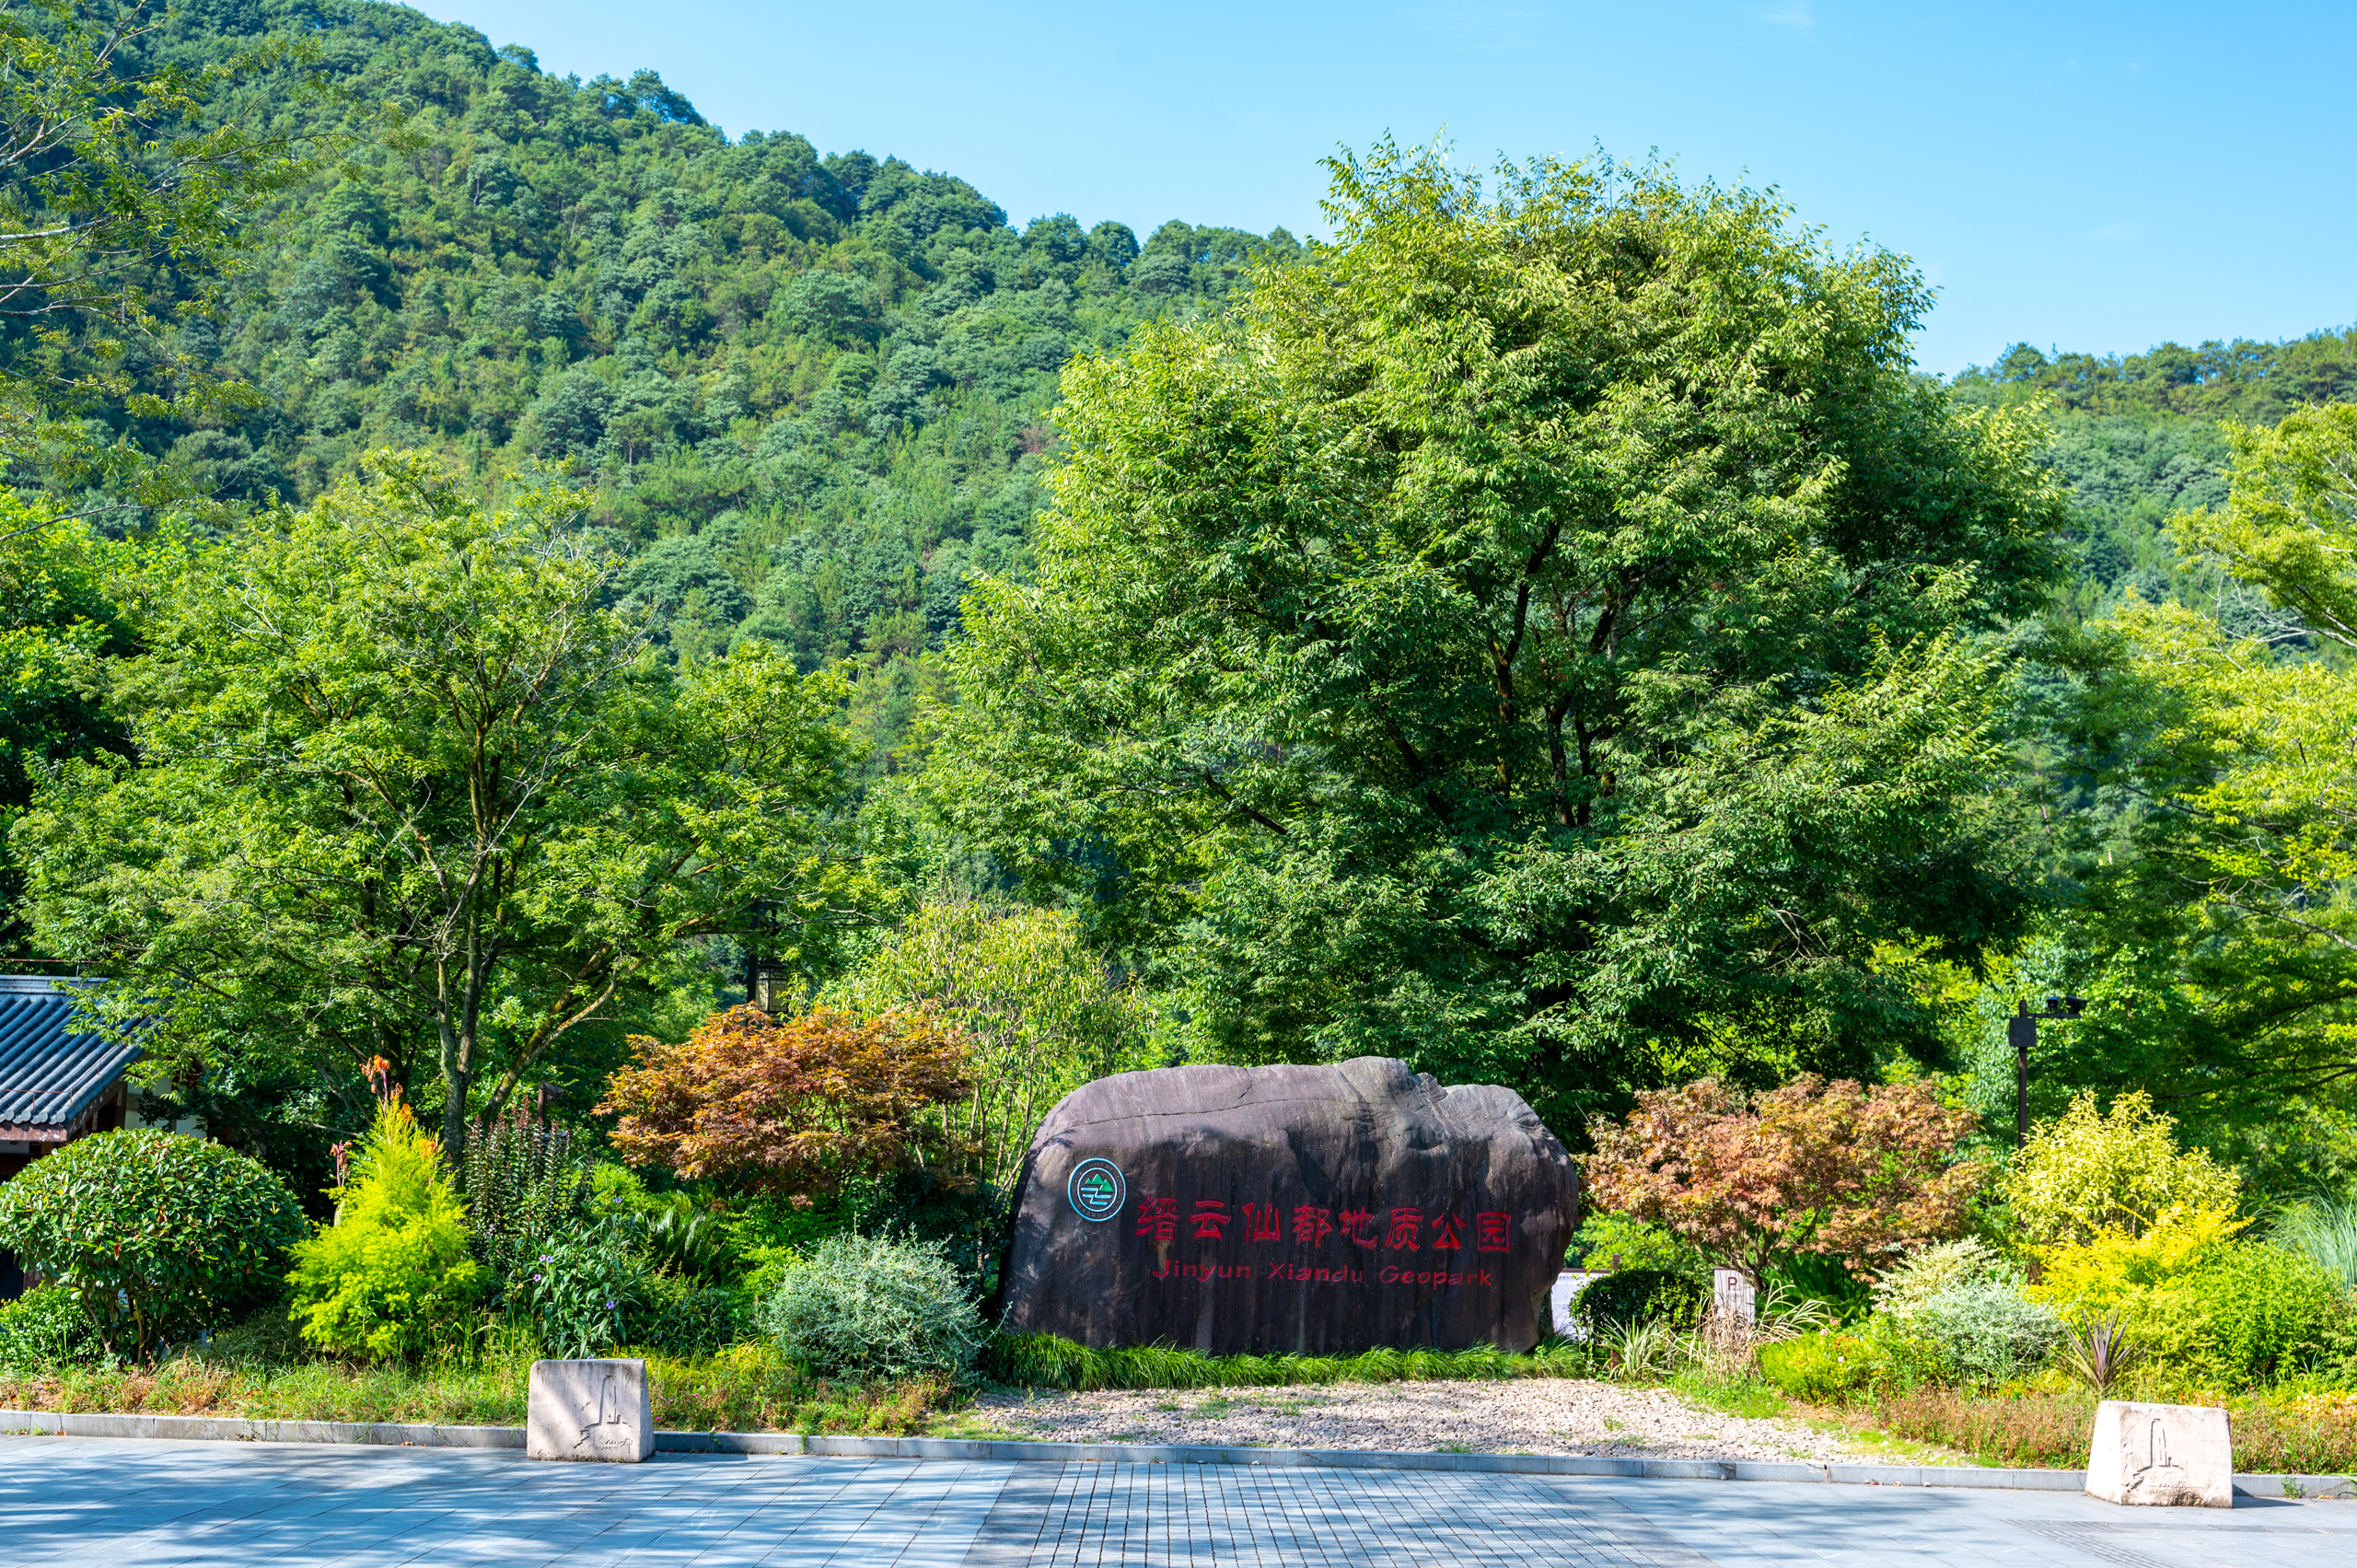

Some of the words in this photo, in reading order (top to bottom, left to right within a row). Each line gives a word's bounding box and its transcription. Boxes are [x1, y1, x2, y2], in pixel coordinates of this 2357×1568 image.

[1135, 1195, 1511, 1253] 缙云仙都地质公园
[1152, 1259, 1250, 1282] Jinyun
[1268, 1261, 1363, 1283] Xiandu
[1378, 1265, 1492, 1291] Geopark
[1727, 1276, 1738, 1291] P
